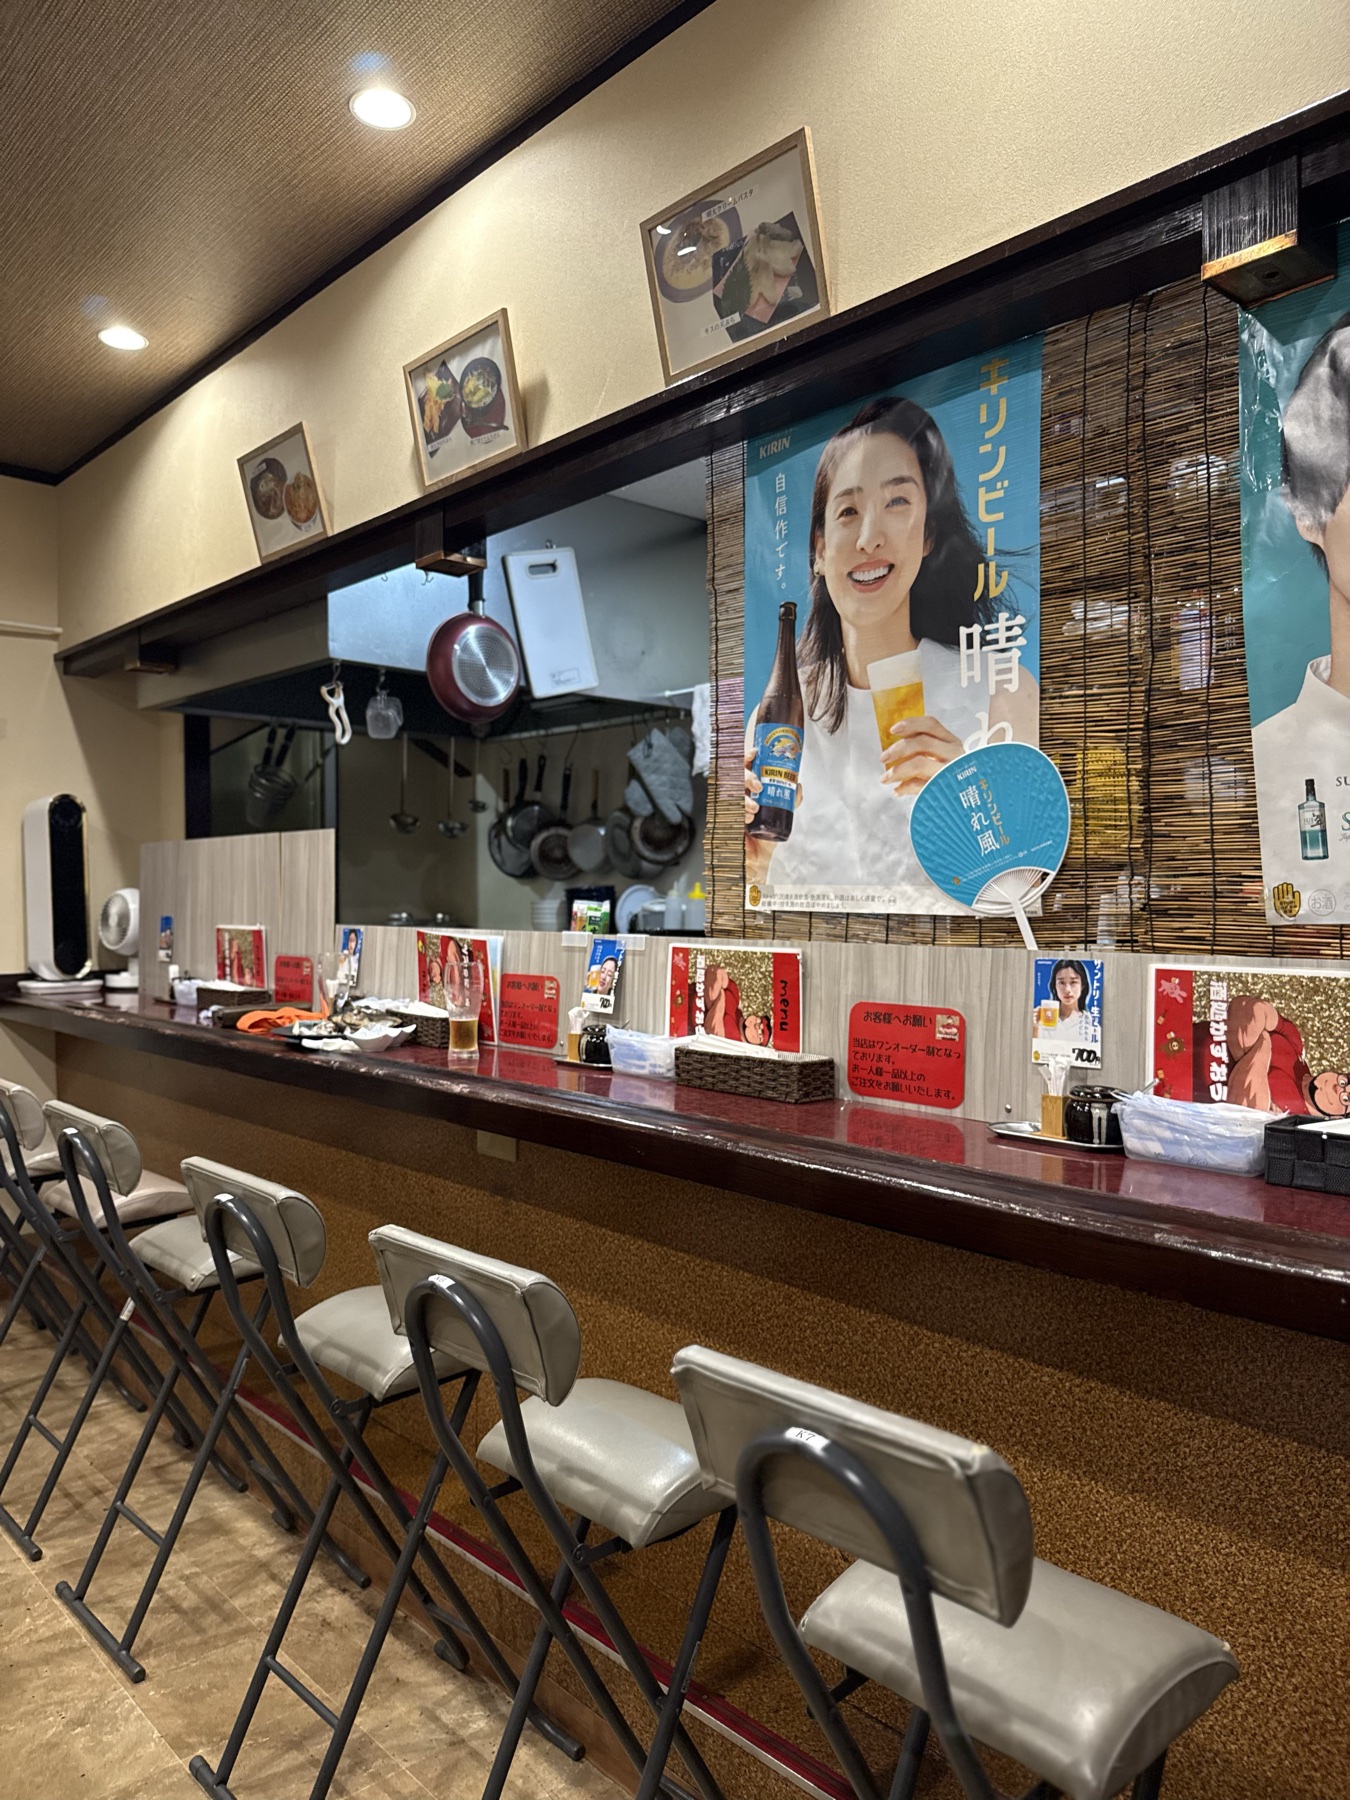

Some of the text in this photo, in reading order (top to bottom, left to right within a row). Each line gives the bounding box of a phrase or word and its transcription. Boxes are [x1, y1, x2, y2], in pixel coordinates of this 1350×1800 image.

[759, 435, 791, 460] KIRIN
[974, 357, 1009, 602] キリンビール
[764, 768, 783, 778] KIRIN
[957, 766, 977, 781] KIRIN
[959, 785, 1000, 857] 晴れ風
[979, 778, 1010, 847] キリンビール
[1311, 896, 1333, 910] お酒
[779, 979, 789, 1032] menu
[1091, 960, 1102, 1043] サントリー生ビール
[863, 1011, 933, 1028] お客様へお願い
[1209, 980, 1229, 1101] 酒処かずおう
[852, 1051, 896, 1065] ております。
[851, 1064, 926, 1082] お一人様一品以上の
[851, 1076, 956, 1100] ご注文をお願いいたします。
[795, 1429, 816, 1442] K7
